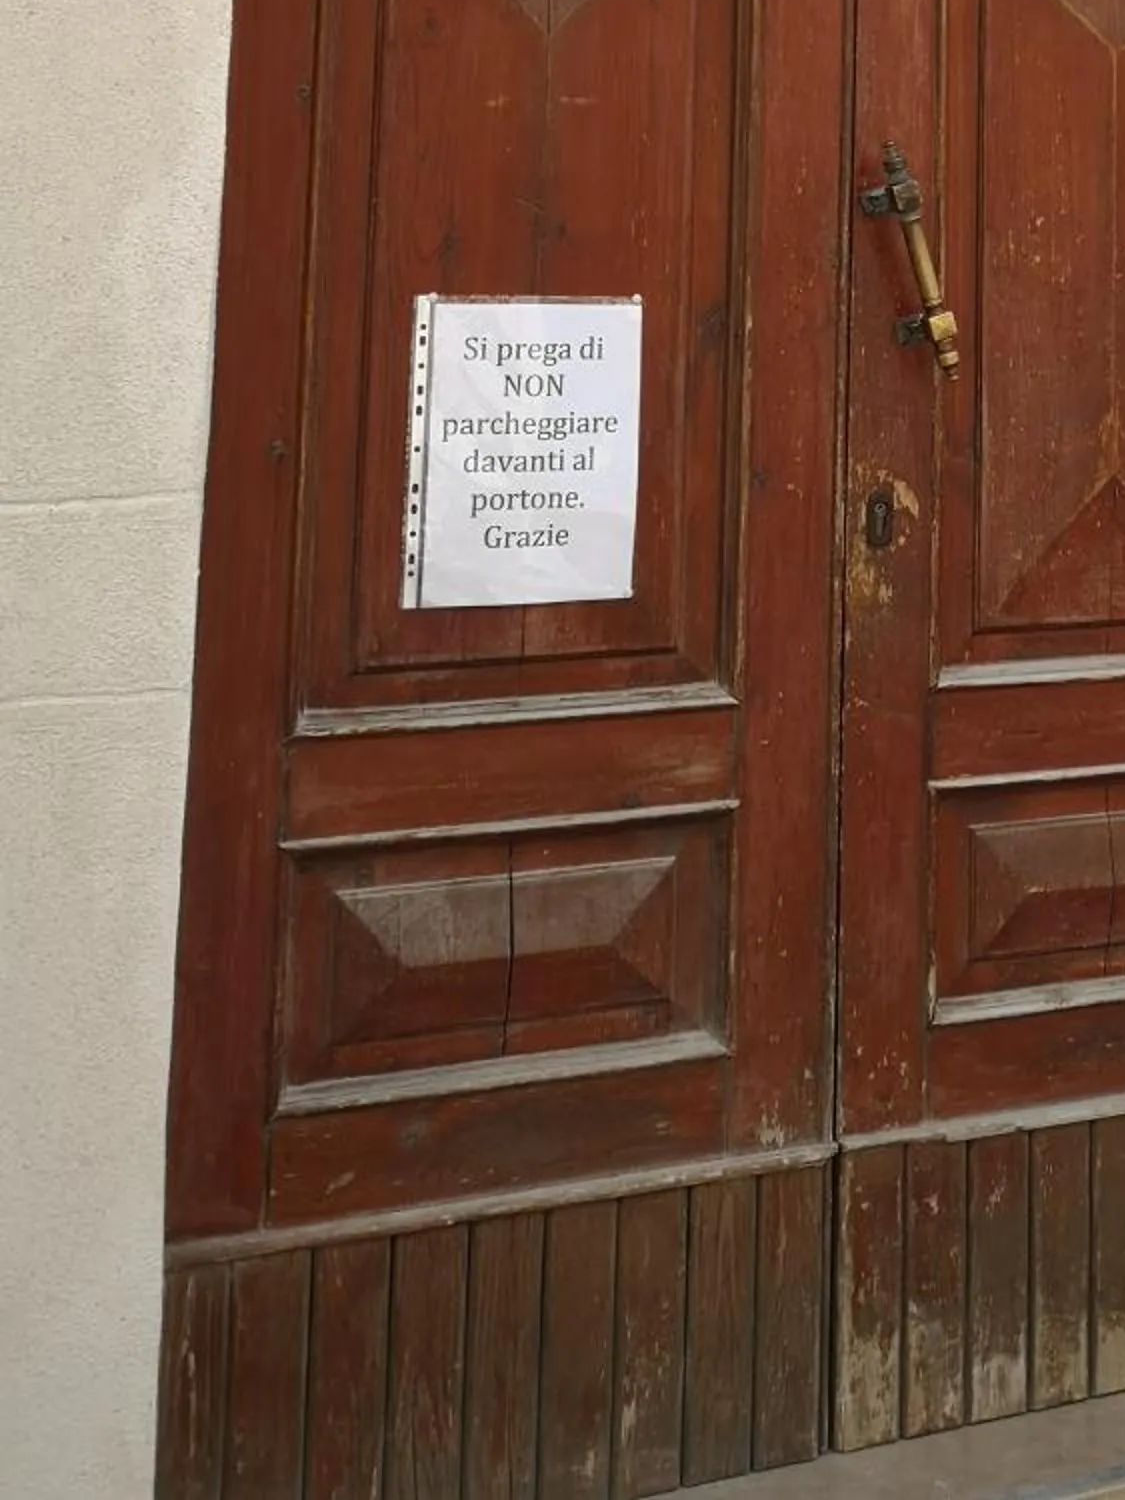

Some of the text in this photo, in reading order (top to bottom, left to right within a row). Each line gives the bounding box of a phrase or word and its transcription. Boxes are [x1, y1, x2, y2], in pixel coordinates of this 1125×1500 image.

[463, 336, 604, 367] Si prega di
[503, 374, 565, 397] NON
[442, 411, 619, 442] parcheggiare
[463, 447, 595, 473] davanti al
[470, 489, 585, 518] portone.
[483, 524, 570, 549] Grazie
